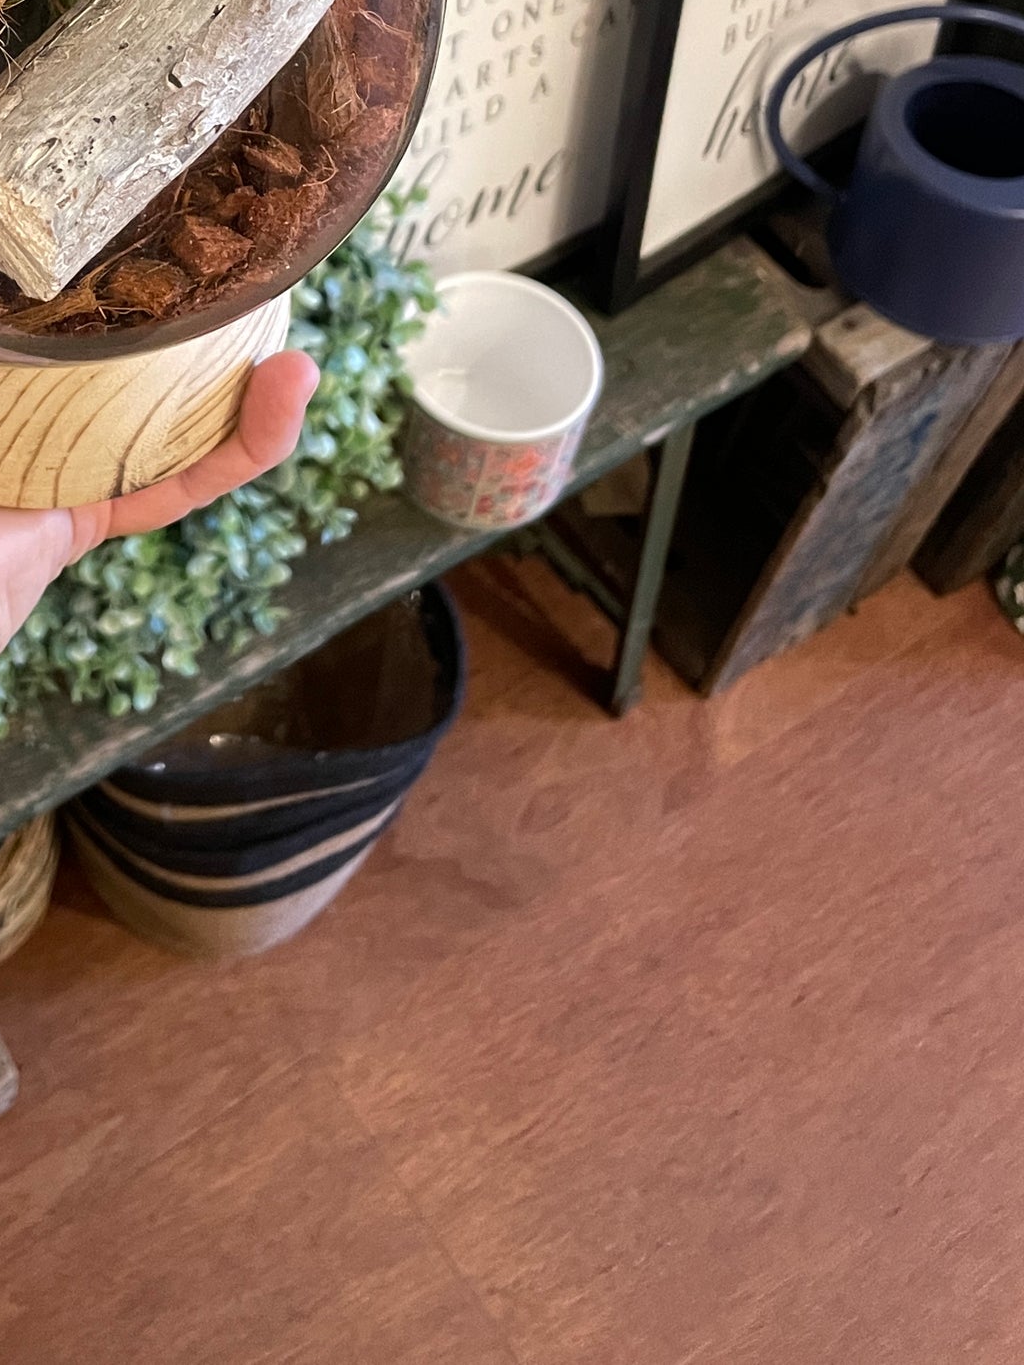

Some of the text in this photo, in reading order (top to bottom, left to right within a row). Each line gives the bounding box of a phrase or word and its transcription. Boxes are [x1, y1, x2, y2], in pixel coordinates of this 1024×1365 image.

[442, 34, 546, 108] ARTS
[410, 72, 553, 158] UILD A
